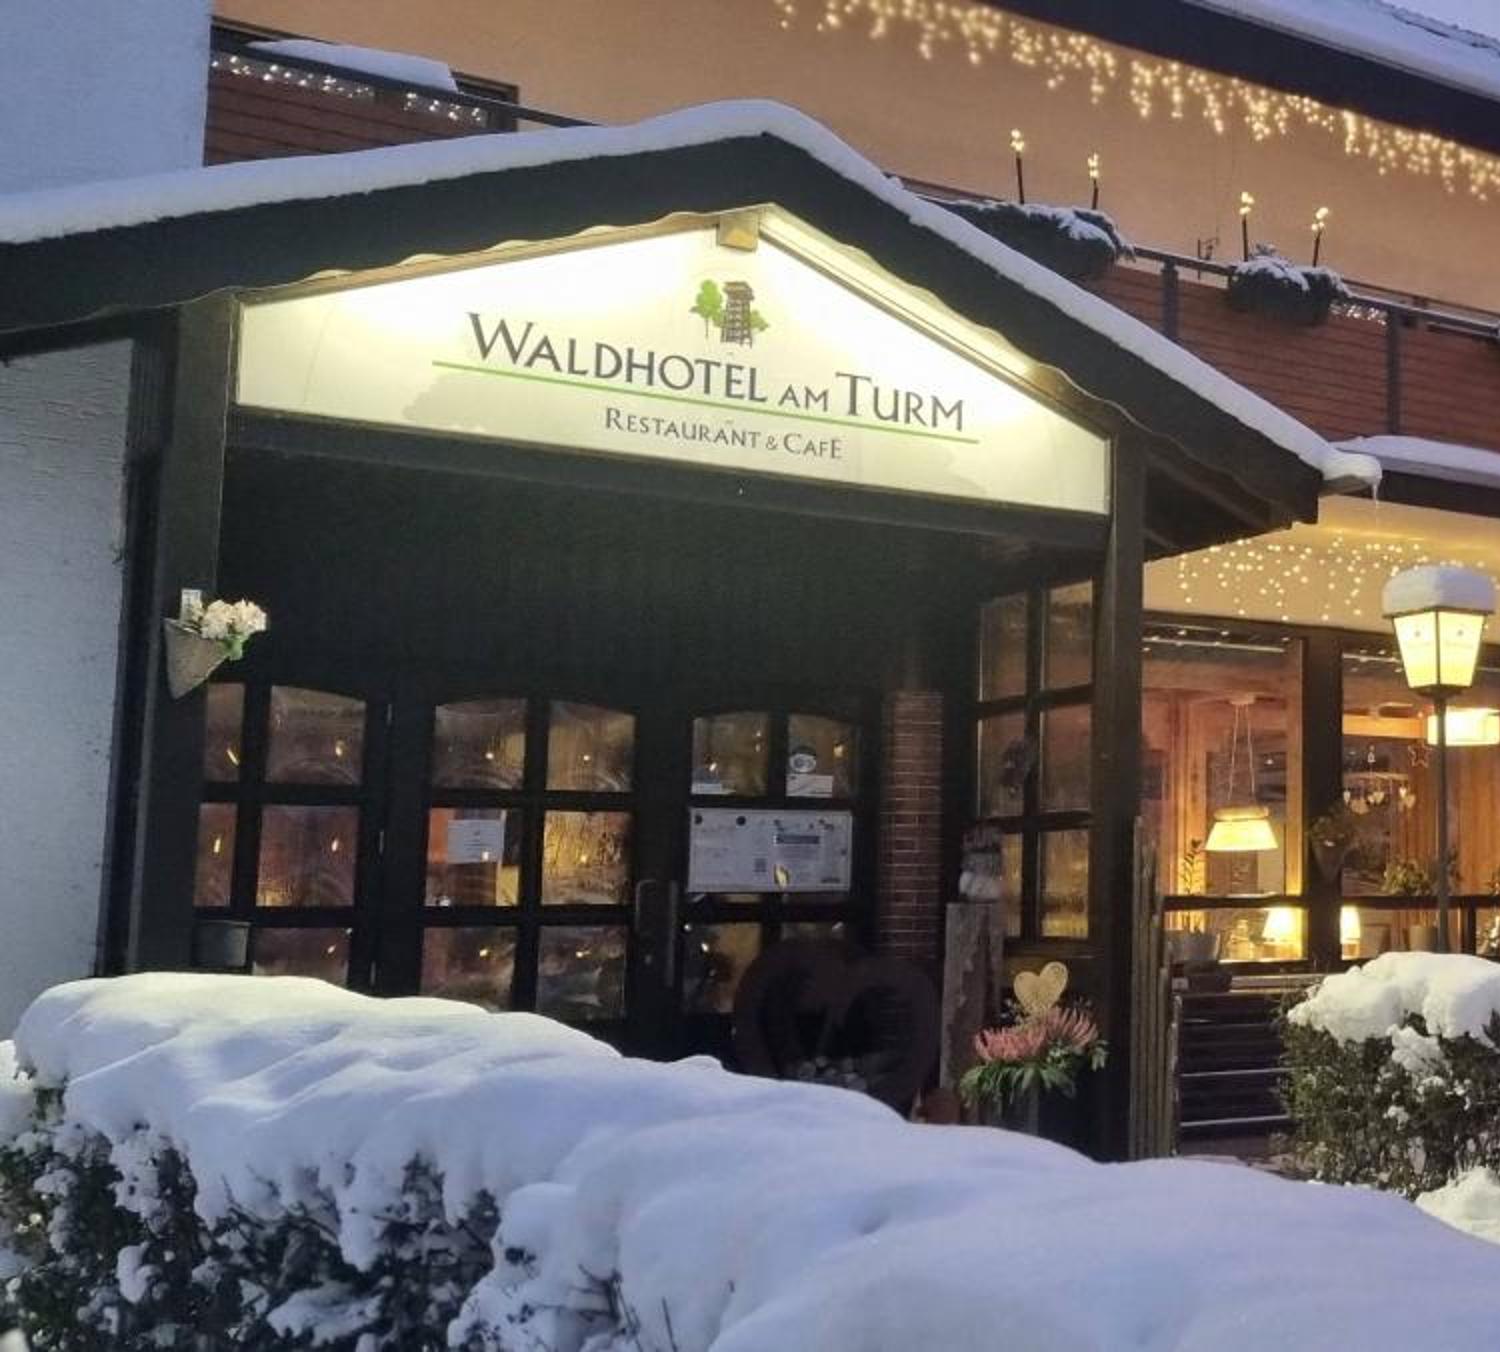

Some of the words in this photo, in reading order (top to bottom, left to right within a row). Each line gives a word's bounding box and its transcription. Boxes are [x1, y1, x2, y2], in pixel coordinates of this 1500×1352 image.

[468, 312, 768, 403] WALDHOTEL
[778, 385, 829, 412] AM
[836, 371, 964, 431] TURM
[604, 407, 762, 450] RESTAURANT
[765, 436, 779, 451] &
